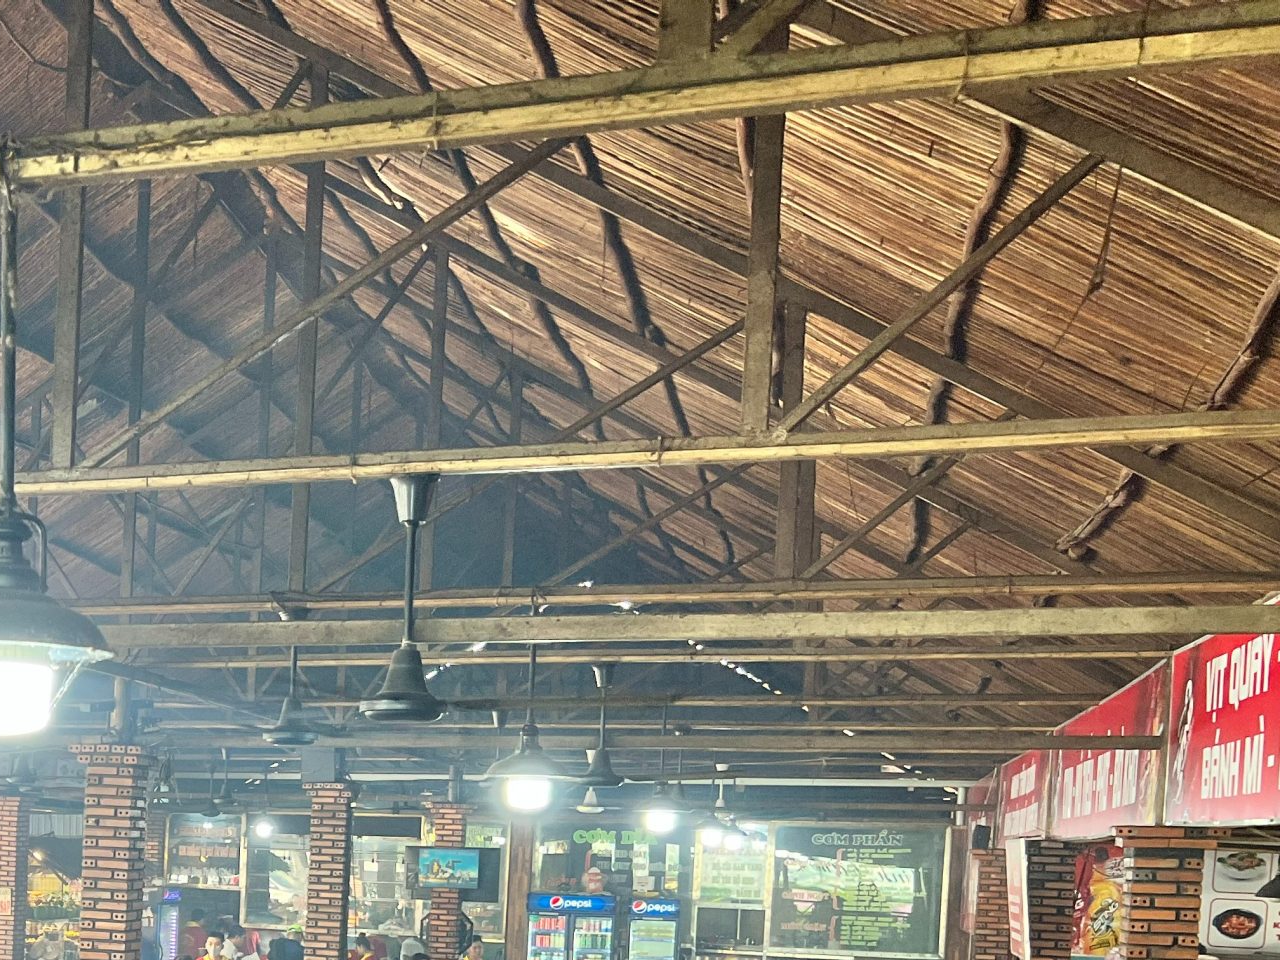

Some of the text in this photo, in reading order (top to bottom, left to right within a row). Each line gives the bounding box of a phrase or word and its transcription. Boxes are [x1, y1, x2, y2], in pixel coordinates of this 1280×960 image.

[1205, 634, 1275, 723] VỊT QUAY
[1201, 727, 1241, 799] BÁNH
[1242, 714, 1264, 795] MÌ
[811, 831, 850, 846] CƠM
[563, 898, 592, 909] pepsi
[646, 902, 677, 914] pepsi
